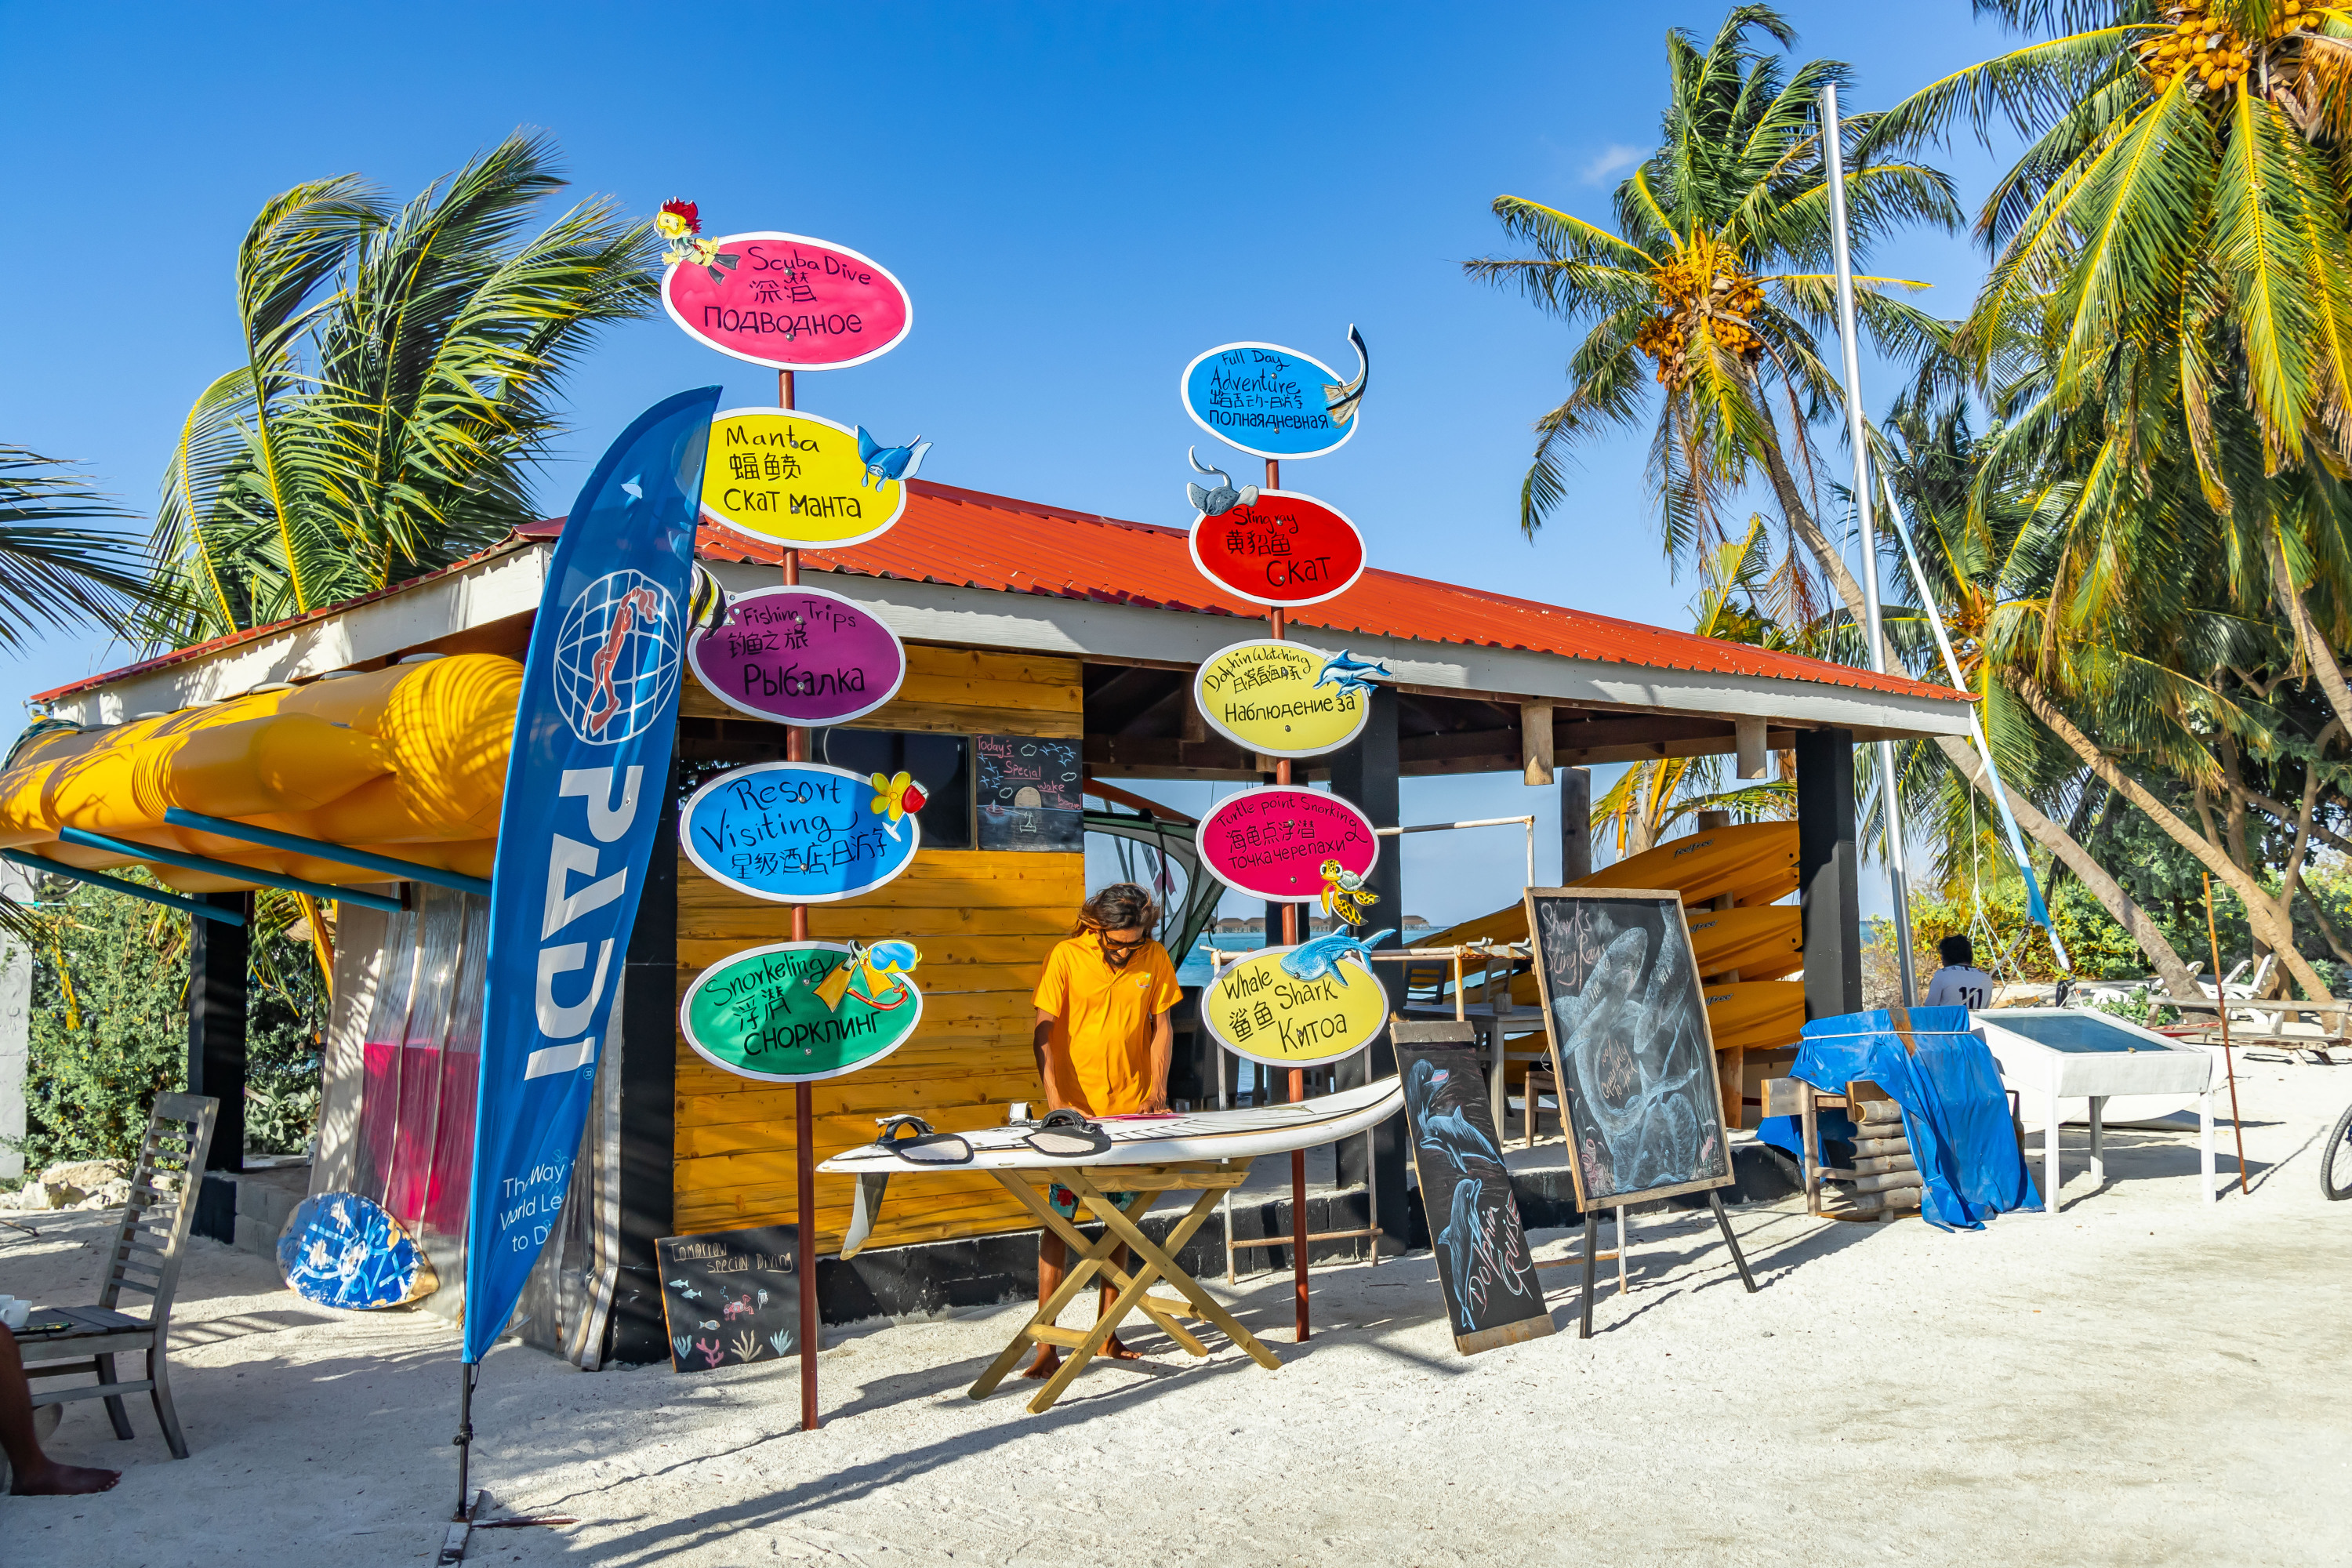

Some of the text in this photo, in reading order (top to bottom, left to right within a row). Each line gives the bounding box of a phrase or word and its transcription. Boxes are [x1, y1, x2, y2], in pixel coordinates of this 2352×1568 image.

[748, 246, 871, 285] Scuba Dive
[1221, 350, 1291, 372] Full Day
[1210, 365, 1301, 394] Adventure
[726, 424, 820, 453] Manta
[742, 601, 857, 633] Fishing Trips
[744, 662, 866, 697] Рыбалка
[1225, 695, 1356, 723] Наблюдение за
[976, 735, 1014, 759] Today's
[1004, 761, 1041, 779] Special
[727, 777, 841, 811] Resort
[1216, 800, 1255, 828] Turtle
[1261, 794, 1295, 816] point
[701, 808, 858, 853] Visiting
[1674, 839, 1715, 858] feelfree
[524, 765, 644, 1081] PADI
[706, 953, 835, 1007] Snorkeling
[1221, 966, 1273, 1000] Whale
[1274, 979, 1338, 1010] Shark
[1705, 993, 1733, 1006] lfree
[1958, 986, 1984, 1009] 10
[530, 1163, 565, 1185] Way
[541, 1193, 565, 1212] Le
[512, 1236, 528, 1252] to
[757, 1252, 793, 1272] Diving
[1468, 1205, 1499, 1319] Dolphin
